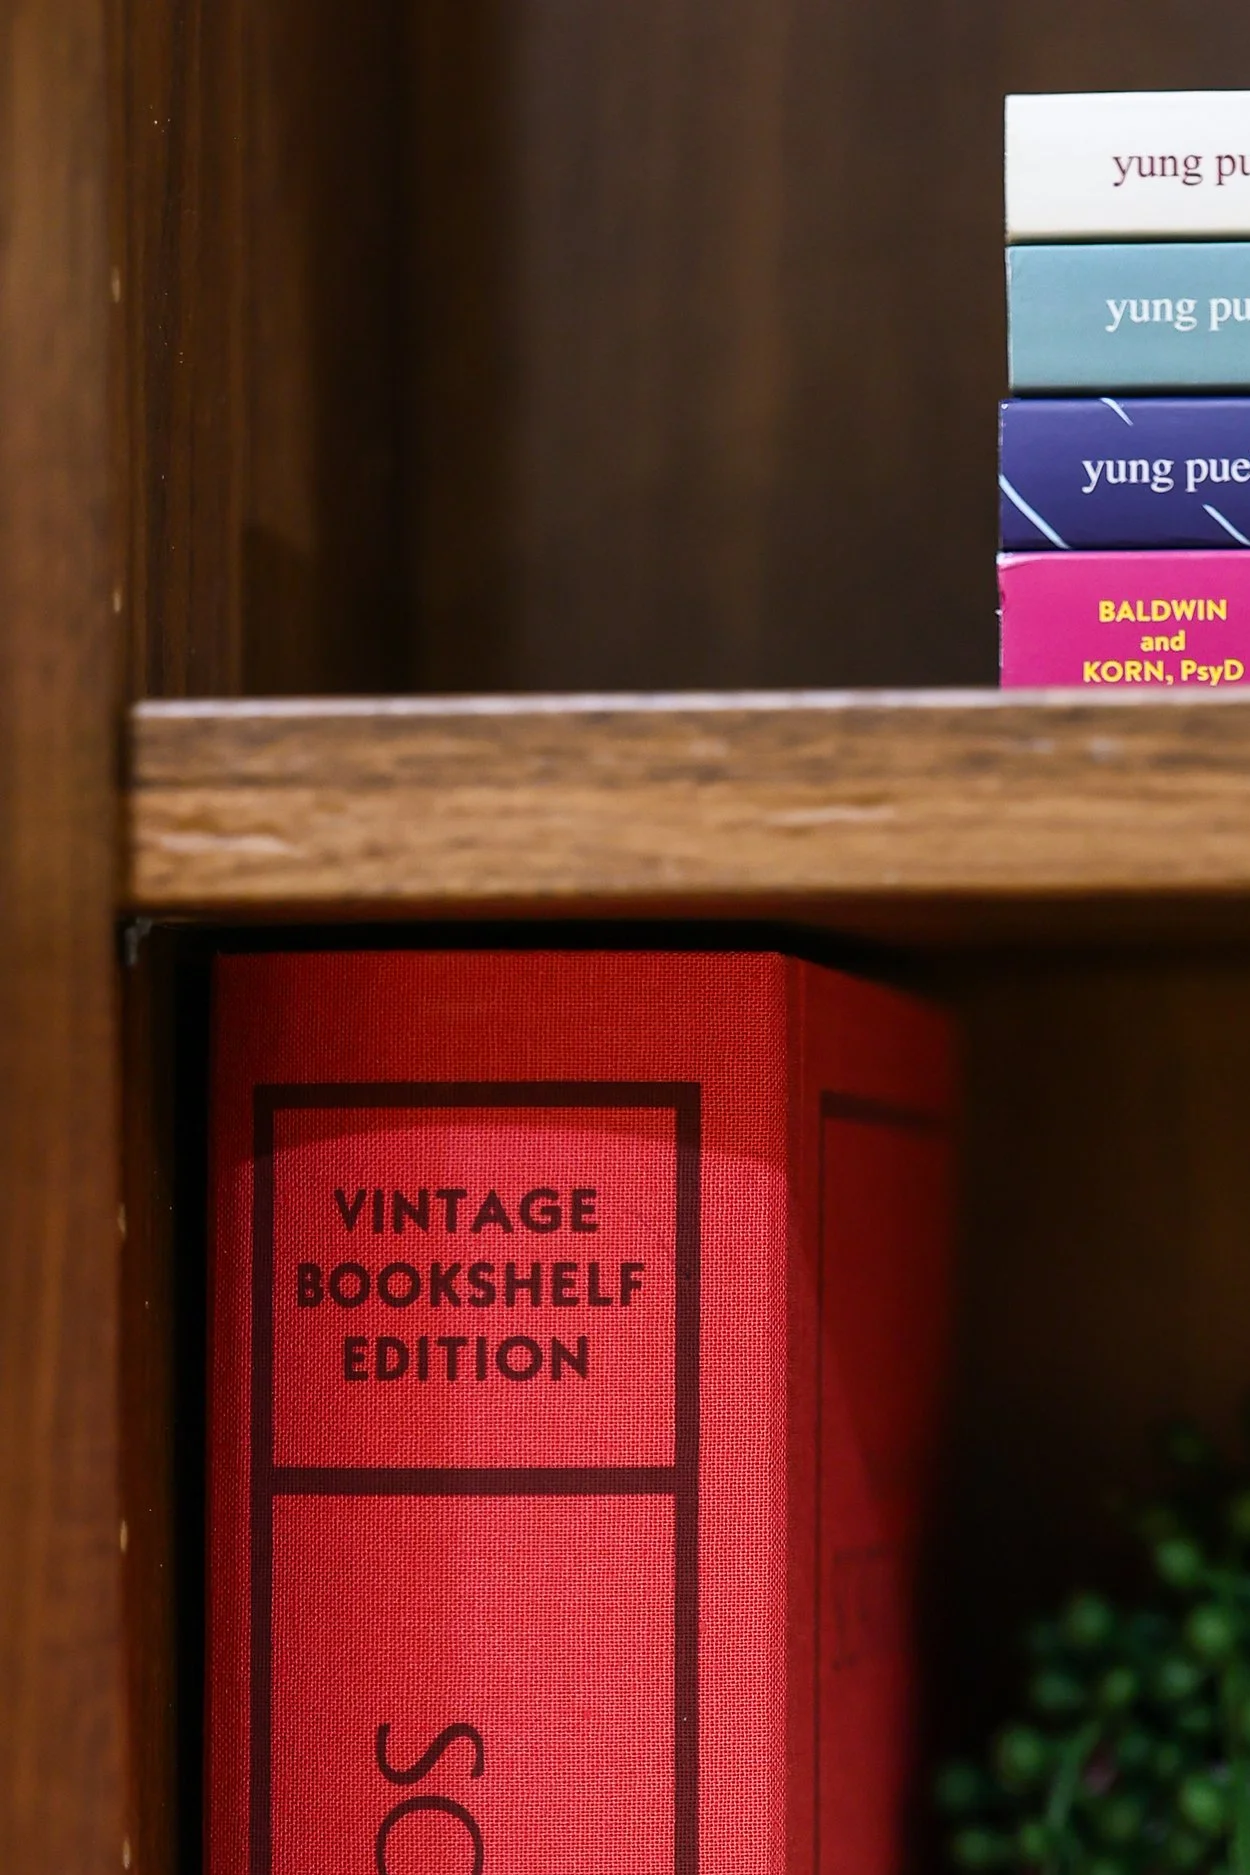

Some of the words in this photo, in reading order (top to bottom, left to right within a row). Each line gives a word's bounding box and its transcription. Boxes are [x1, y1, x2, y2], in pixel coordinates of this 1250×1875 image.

[1112, 150, 1203, 187] yung
[1105, 292, 1198, 332] yung
[1081, 454, 1174, 493] yung
[1098, 599, 1228, 622] BALDWIN
[1140, 629, 1186, 652] and
[1083, 660, 1174, 685] KORN,
[1180, 659, 1244, 686] PsyD
[333, 1188, 599, 1234] VINTAGE
[297, 1261, 645, 1309] BOOKSHELF
[343, 1336, 589, 1382] EDITION
